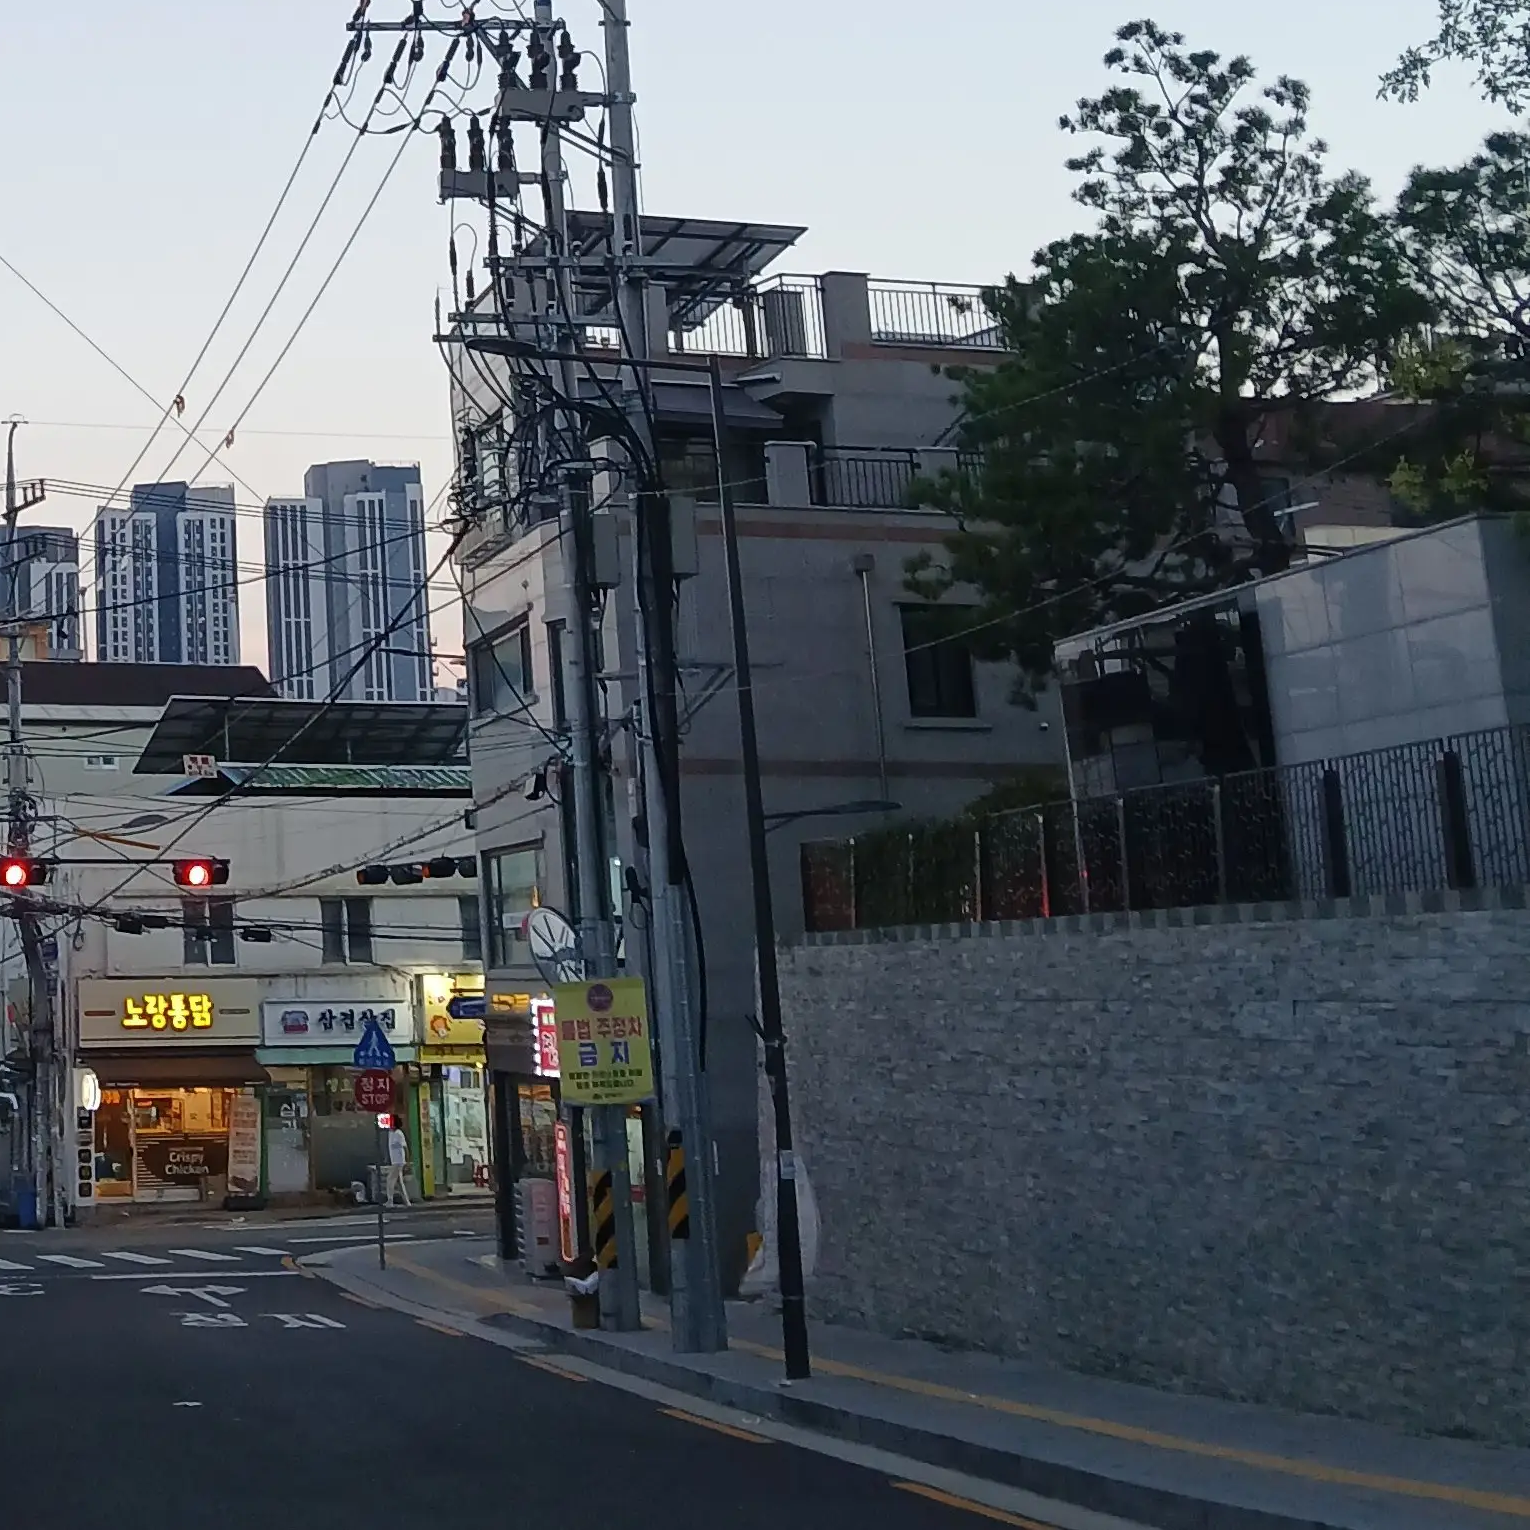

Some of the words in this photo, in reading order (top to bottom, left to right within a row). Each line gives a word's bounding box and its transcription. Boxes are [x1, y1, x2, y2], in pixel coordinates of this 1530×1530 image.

[121, 993, 214, 1031] 노랑통닭
[360, 1077, 390, 1092] 정지
[361, 1093, 389, 1105] STOP
[169, 1152, 204, 1165] Crispy
